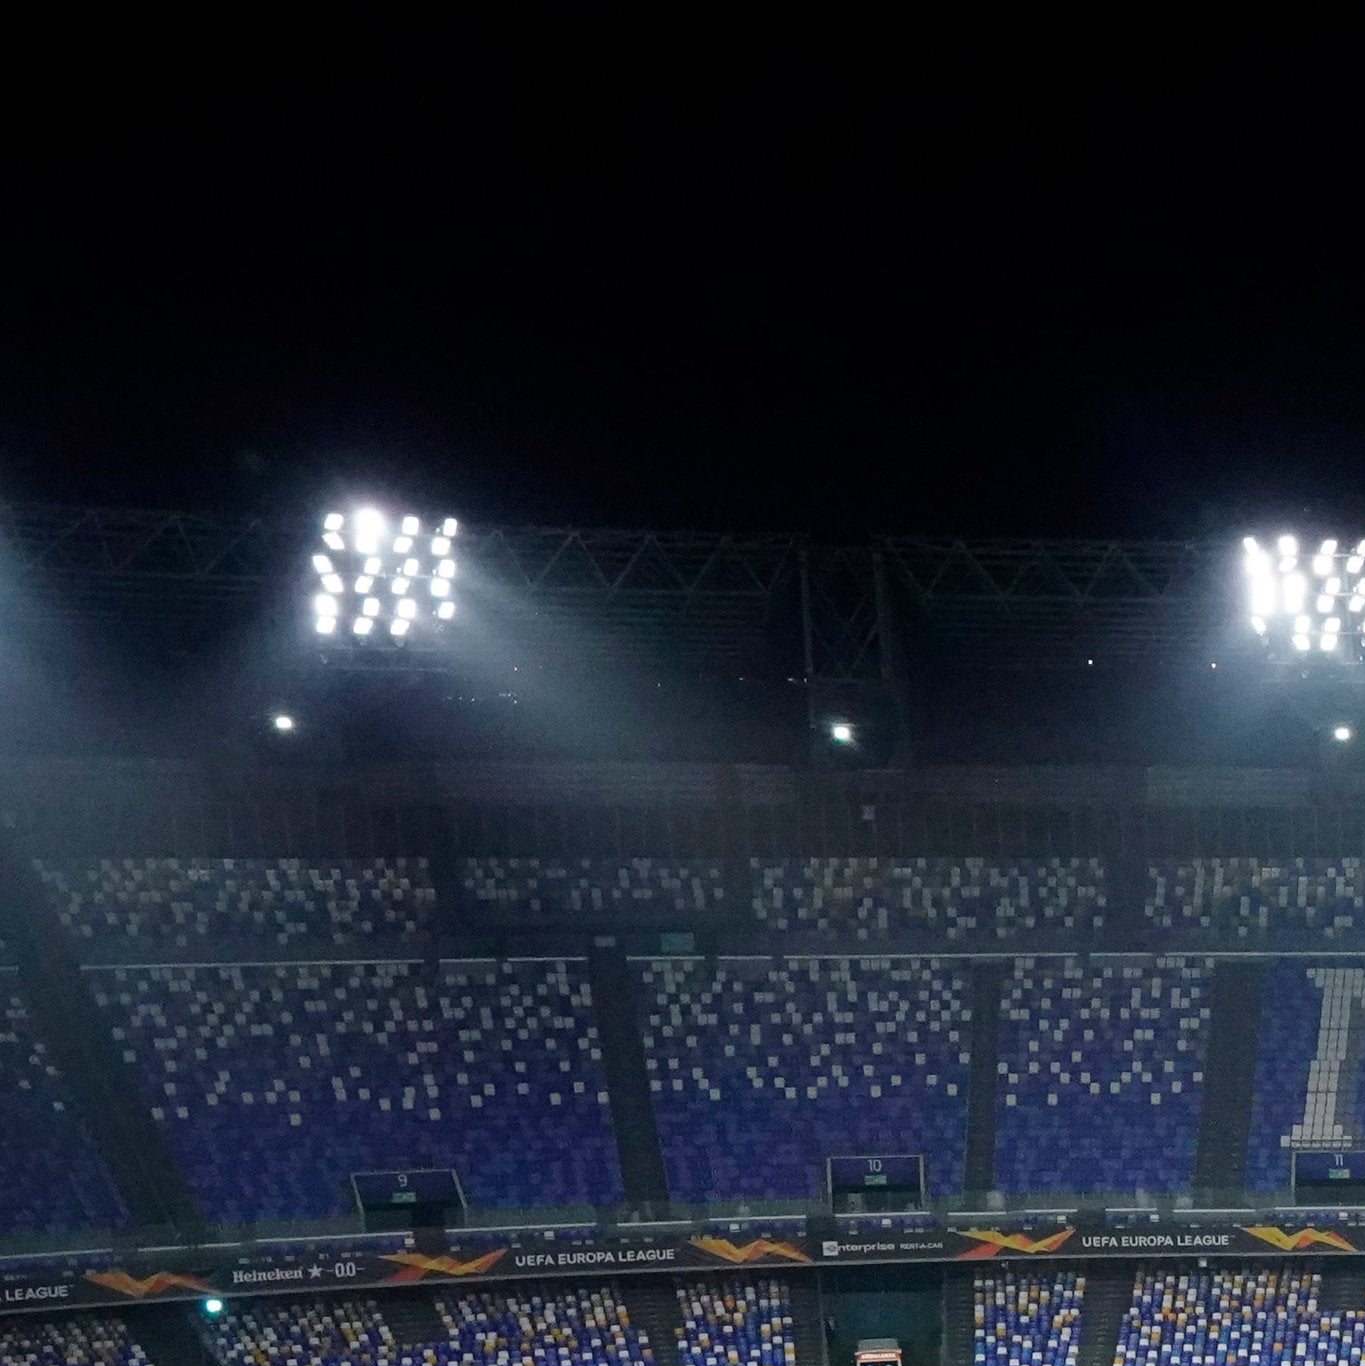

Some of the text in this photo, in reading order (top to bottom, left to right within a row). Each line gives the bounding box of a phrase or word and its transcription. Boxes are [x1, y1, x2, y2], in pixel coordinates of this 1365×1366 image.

[867, 1159, 882, 1172] 10
[398, 1173, 408, 1187] 9
[824, 1241, 896, 1254] enterprise
[1082, 1234, 1230, 1248] UEFA EUROPA LEAGUE
[515, 1248, 675, 1268] UEFA EUROPA LEAGUE
[232, 1266, 304, 1284] Heineken
[5, 1285, 69, 1301] LEAGUE
